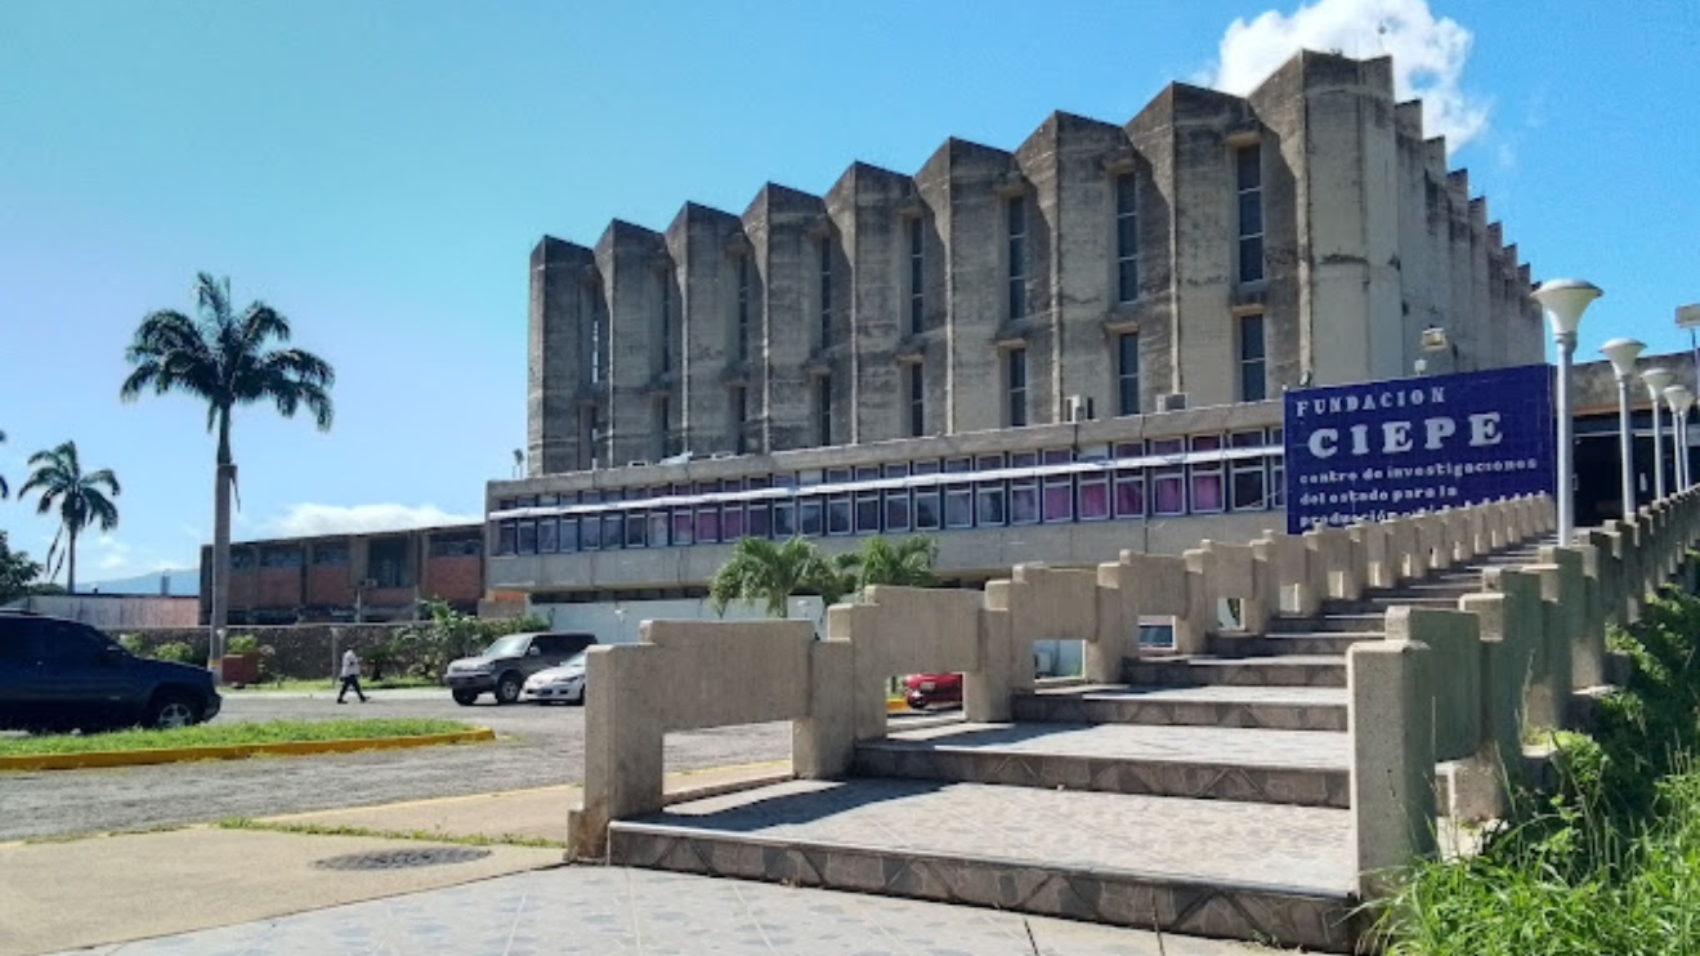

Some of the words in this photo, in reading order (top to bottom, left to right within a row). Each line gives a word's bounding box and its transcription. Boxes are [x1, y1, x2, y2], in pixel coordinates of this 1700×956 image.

[1296, 387, 1446, 417] FUNDACION
[1308, 411, 1503, 458] CIEPE
[1300, 470, 1358, 484] centro
[1362, 467, 1383, 480] de
[1387, 458, 1537, 479] investigaciones
[1300, 492, 1326, 506] del
[1329, 489, 1388, 504] estado
[1392, 487, 1435, 503] para
[1439, 485, 1458, 498] la
[1300, 509, 1398, 528] produió
